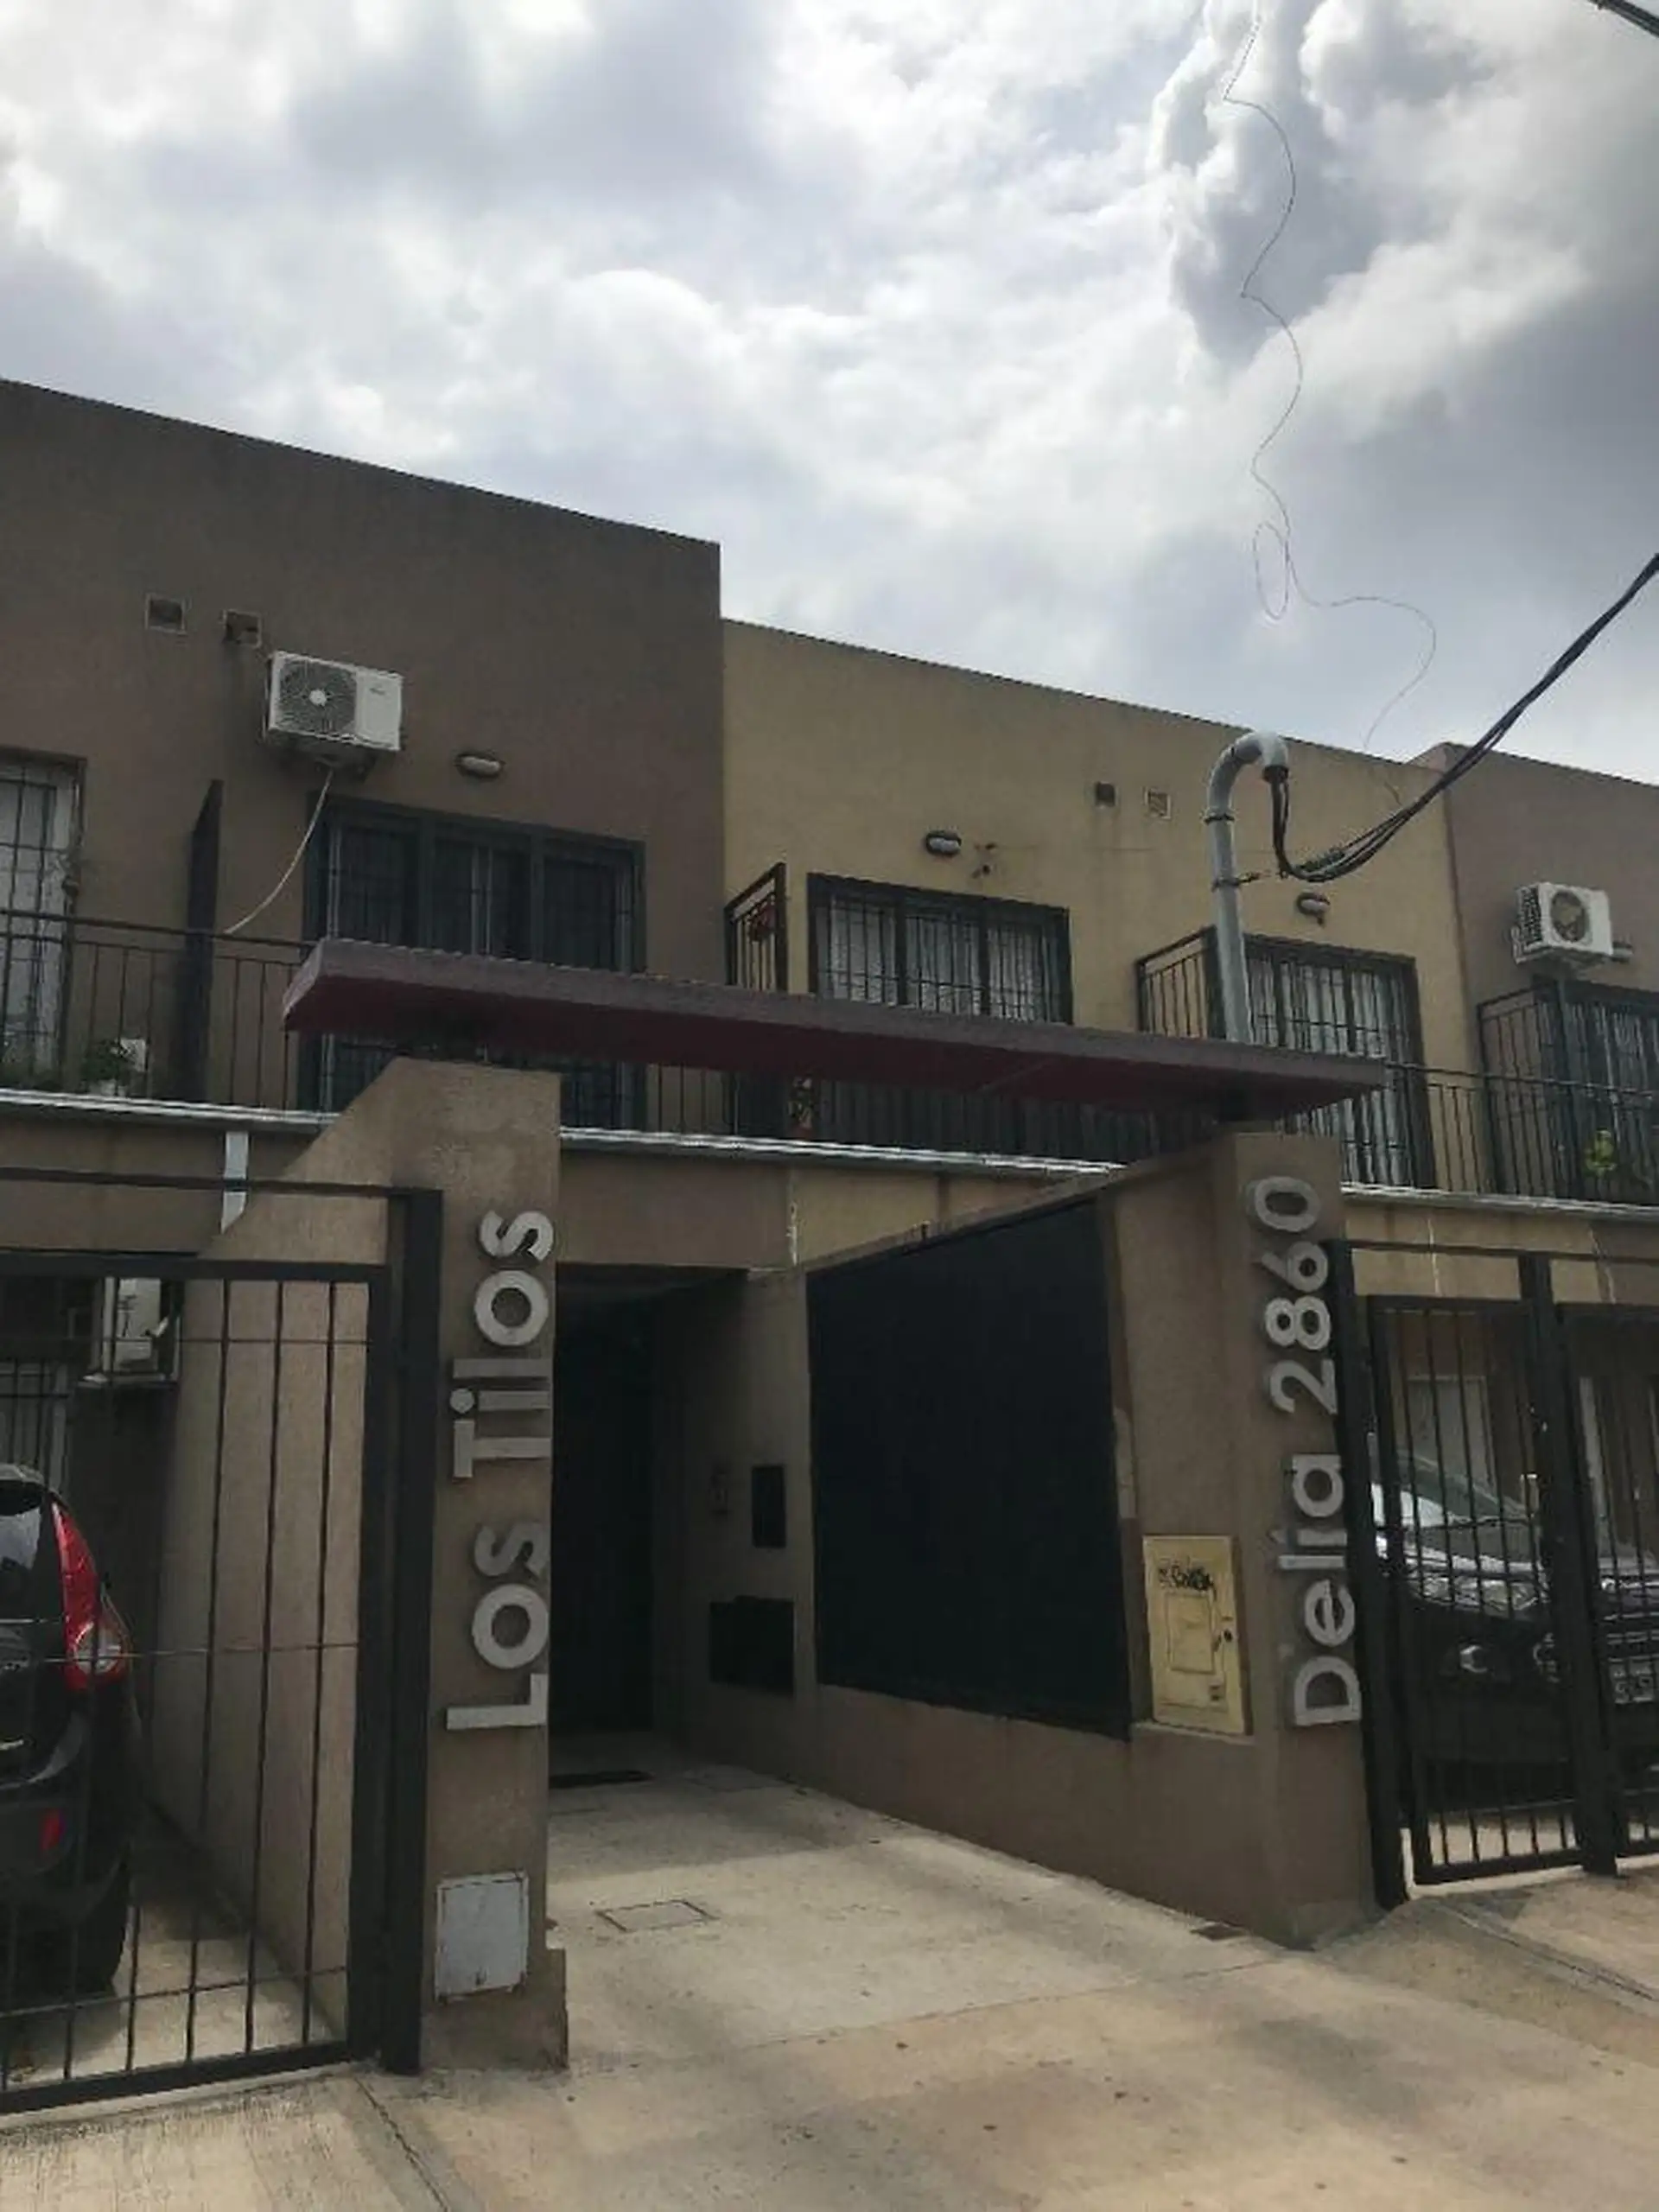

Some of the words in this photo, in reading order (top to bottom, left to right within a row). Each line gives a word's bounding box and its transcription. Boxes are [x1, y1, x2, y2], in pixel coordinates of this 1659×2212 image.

[449, 1210, 555, 1478] Tilos
[1253, 1175, 1338, 1415] 2860
[446, 1521, 550, 1731] Los
